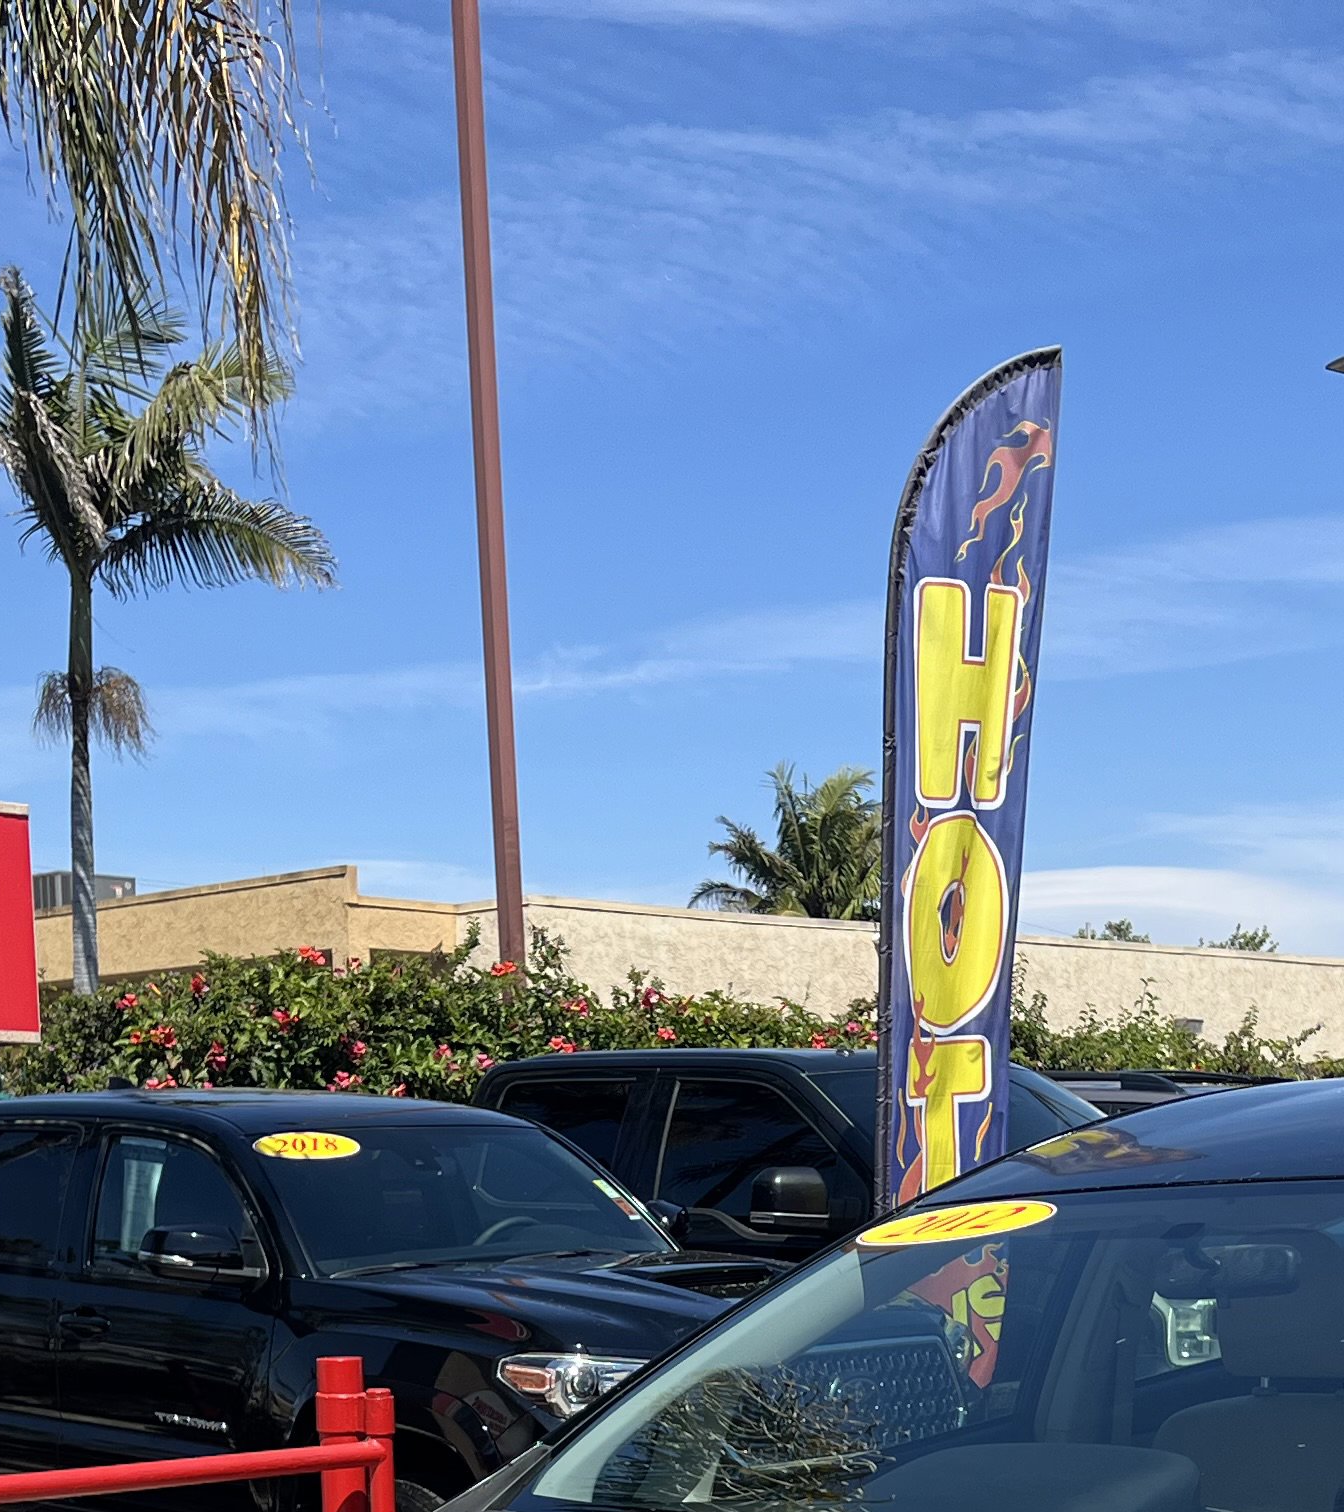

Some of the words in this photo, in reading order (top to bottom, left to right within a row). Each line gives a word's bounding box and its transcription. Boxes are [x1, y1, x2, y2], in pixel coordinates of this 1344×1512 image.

[903, 576, 1023, 1194] HOT
[274, 1137, 339, 1153] 2018
[879, 1206, 1028, 1240] 2012
